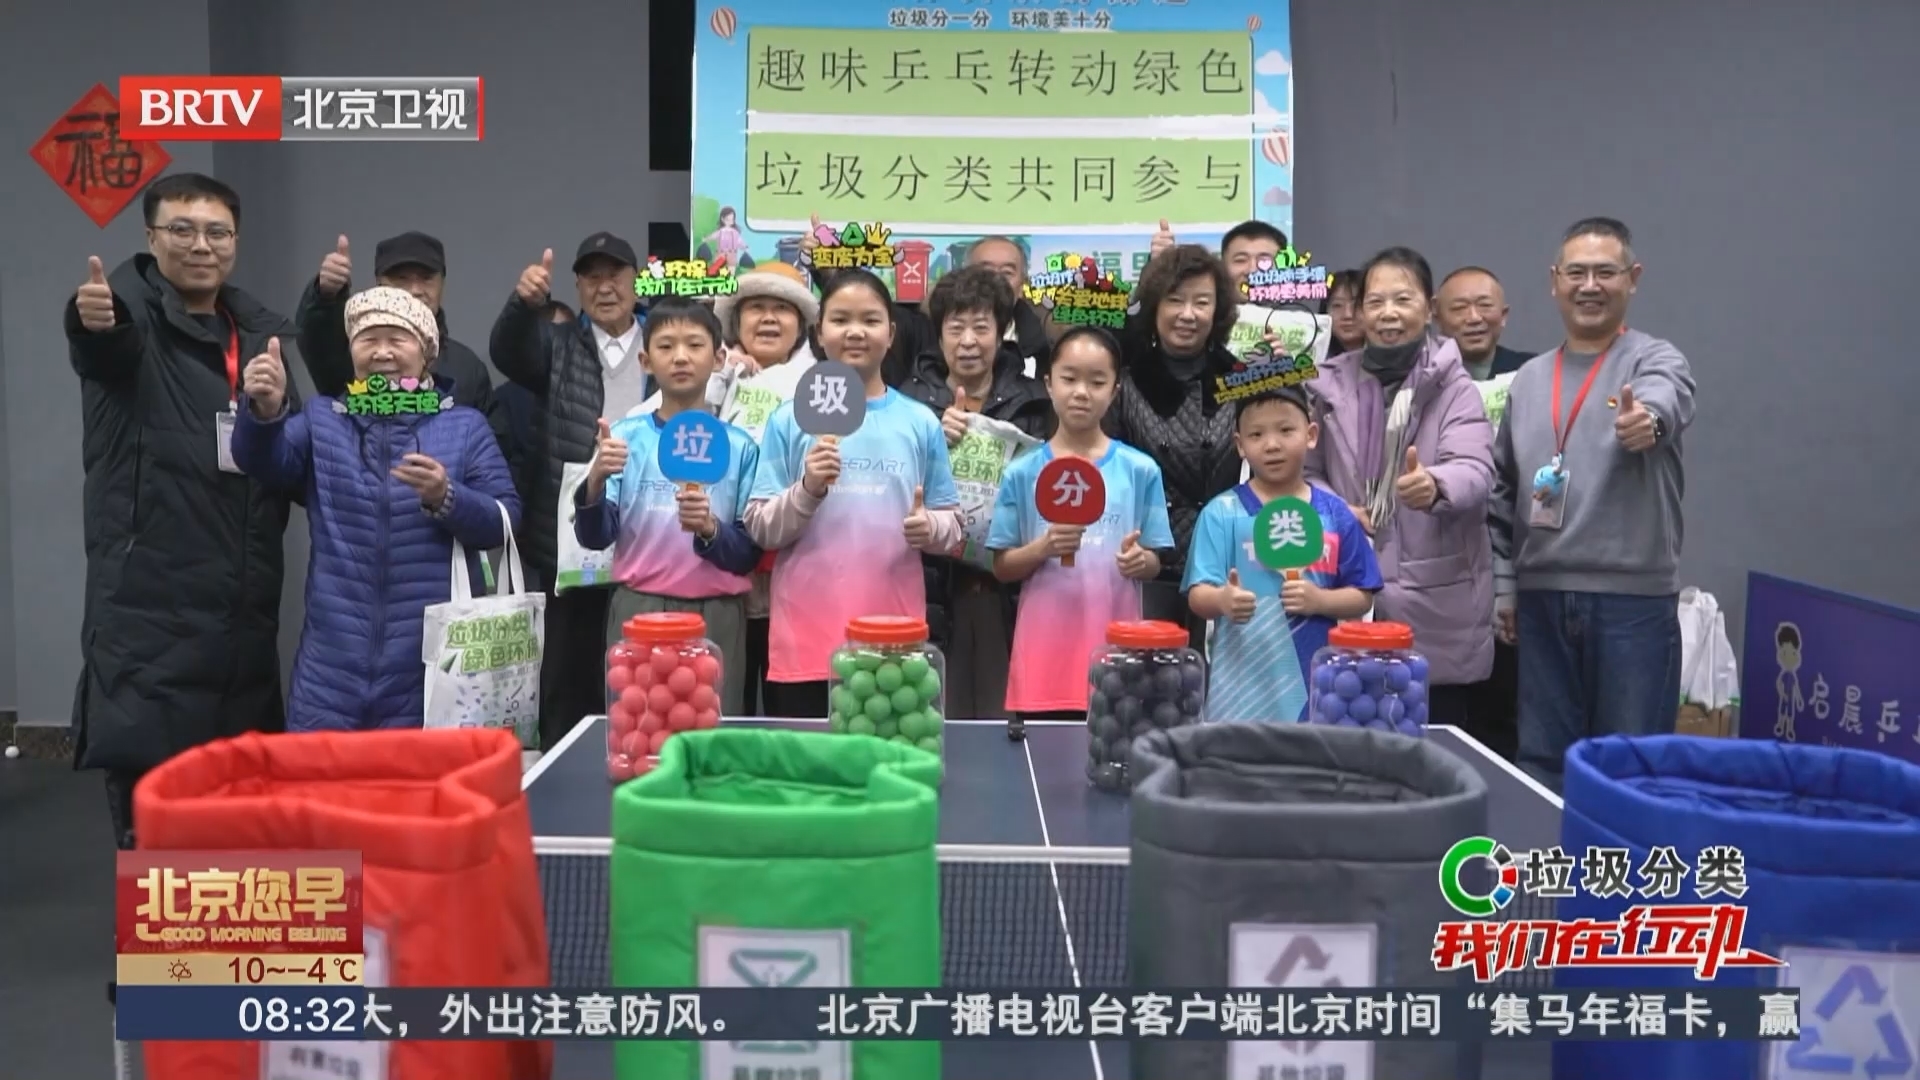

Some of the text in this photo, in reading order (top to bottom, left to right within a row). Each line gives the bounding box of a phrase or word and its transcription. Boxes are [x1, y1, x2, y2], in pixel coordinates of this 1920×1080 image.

[888, 8, 1112, 29] 垃圾分一分 环境美十分
[757, 45, 1245, 96] 趣味乒乓转动绿色
[54, 111, 143, 196] 福
[756, 151, 1243, 203] 垃圾分类共同参与
[346, 391, 439, 415] 环保天使
[809, 374, 849, 415] 圾
[672, 423, 713, 463] 垃
[1051, 470, 1091, 508] 分
[1268, 509, 1309, 551] 类
[447, 611, 531, 645] 垃圾分类
[1808, 671, 1920, 744] 启晨乒
